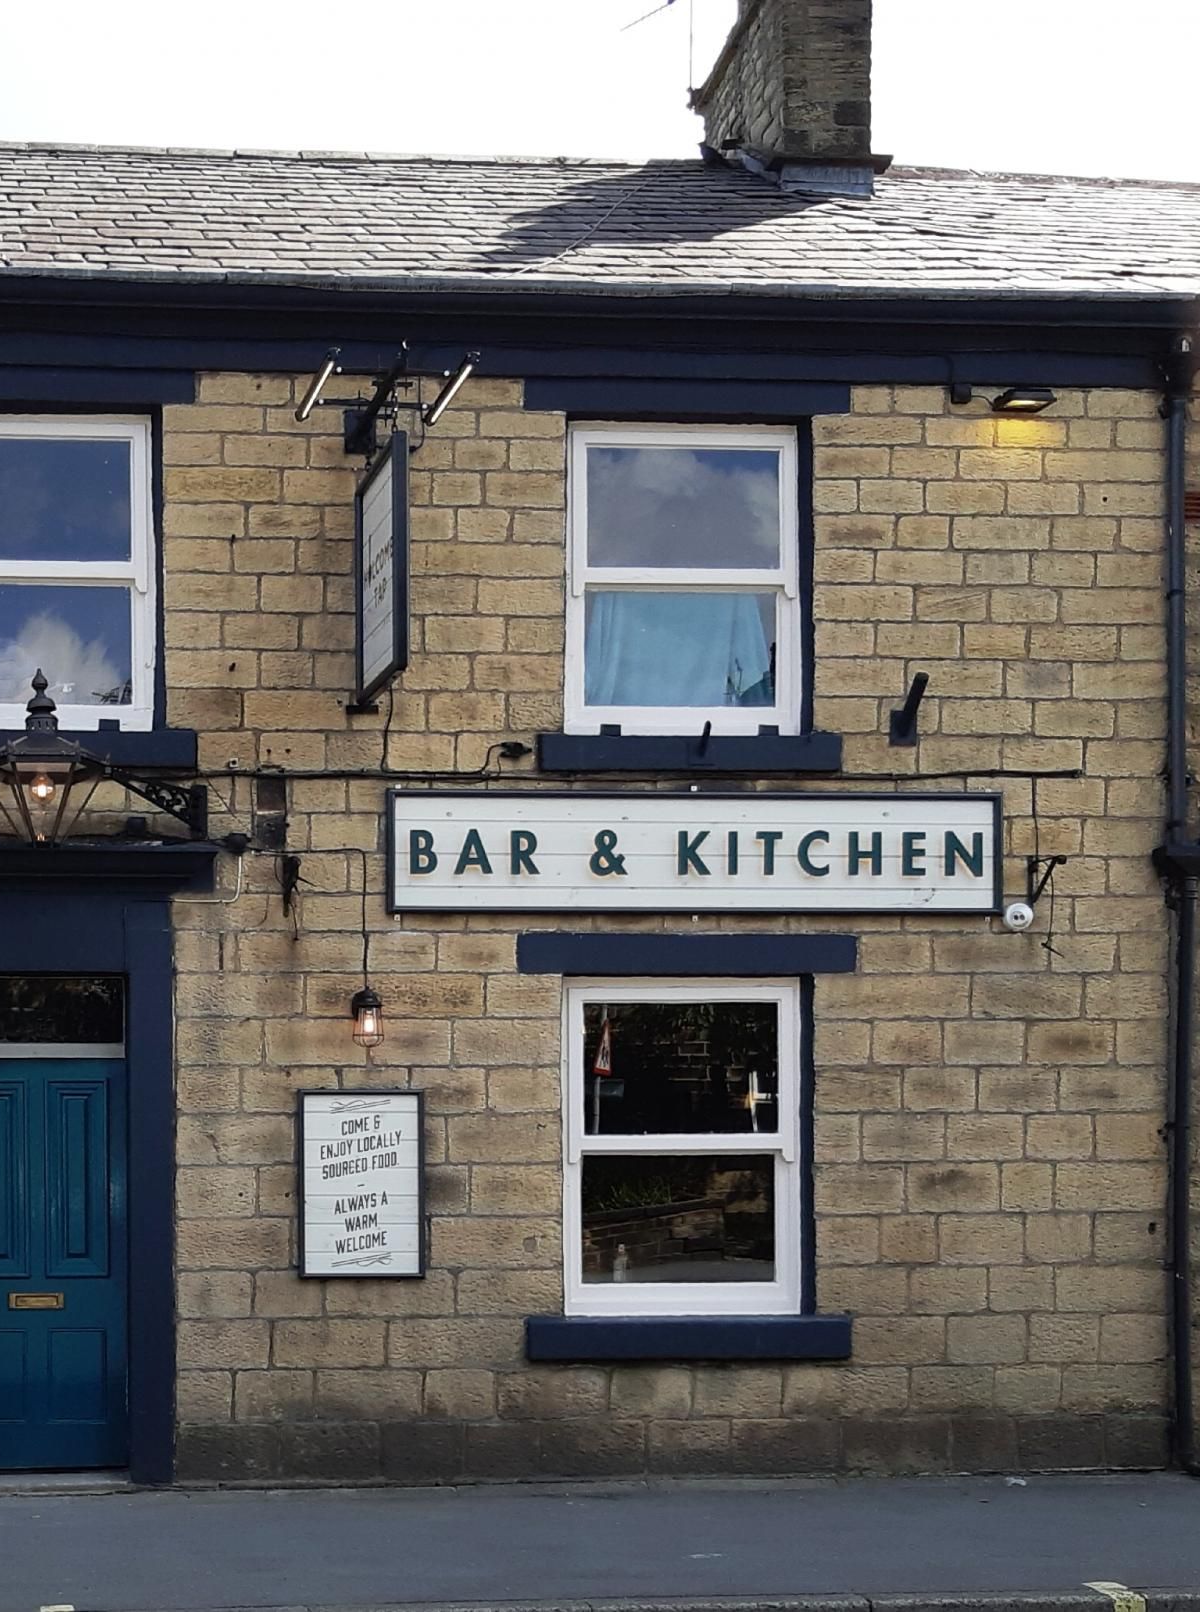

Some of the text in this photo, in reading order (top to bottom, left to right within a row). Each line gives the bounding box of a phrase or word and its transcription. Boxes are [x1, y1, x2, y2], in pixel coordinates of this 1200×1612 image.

[408, 828, 984, 878] BAR & KITCHEN
[341, 1114, 381, 1136] COME &
[320, 1130, 402, 1160] ENJOY LOCALLY
[322, 1151, 400, 1180] SOURCED FOOD.
[334, 1191, 388, 1215] ALWAYS A
[344, 1212, 378, 1233] WARM
[335, 1230, 388, 1255] WELCOME
